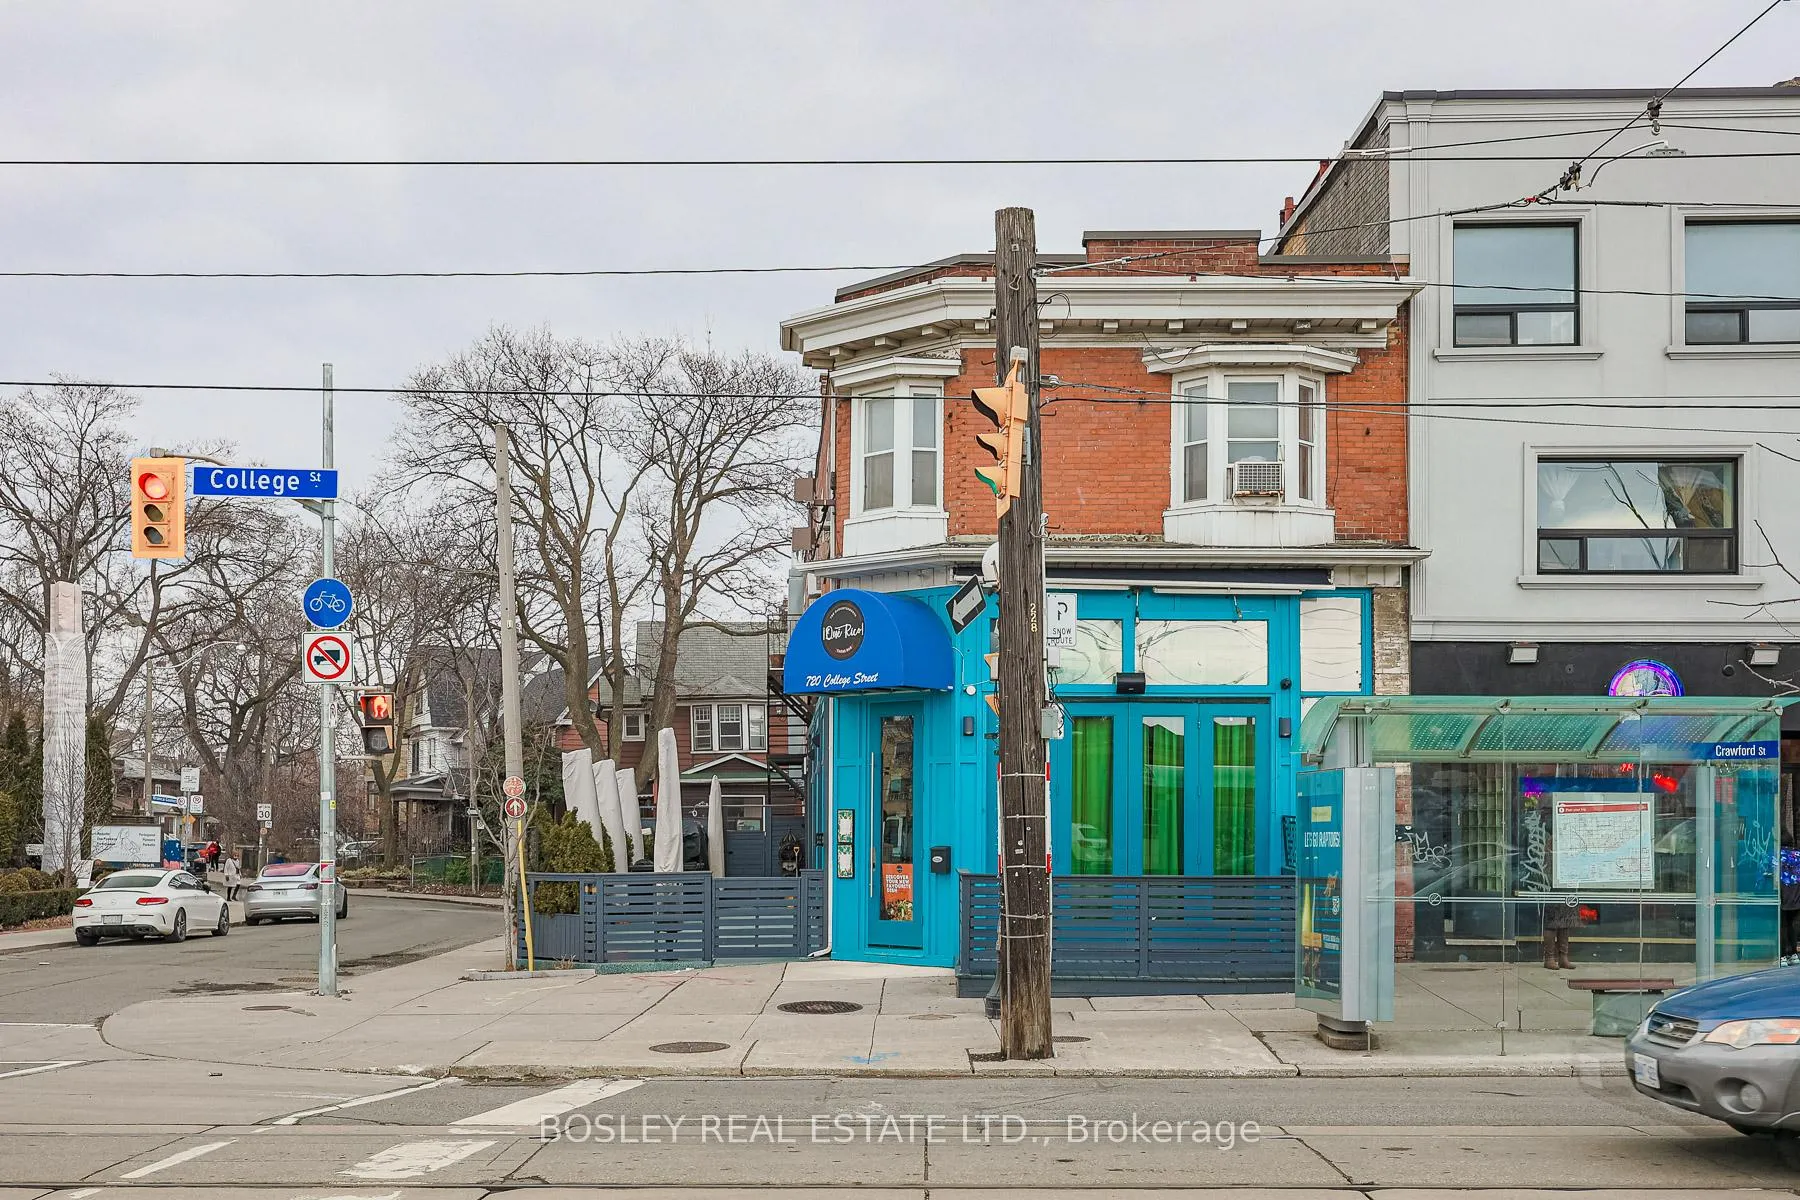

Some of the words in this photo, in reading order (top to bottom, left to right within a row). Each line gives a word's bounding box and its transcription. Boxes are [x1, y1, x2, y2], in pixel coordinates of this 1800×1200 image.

[210, 469, 300, 495] College
[309, 471, 321, 482] St
[1030, 602, 1038, 632] 228
[1053, 627, 1071, 635] SNOW
[1051, 636, 1072, 645] ROUTE
[806, 675, 821, 687] 720
[823, 673, 851, 688] College
[853, 672, 879, 685] Street
[1715, 744, 1756, 757] Crawford
[1758, 746, 1766, 756] St
[259, 811, 270, 819] 30
